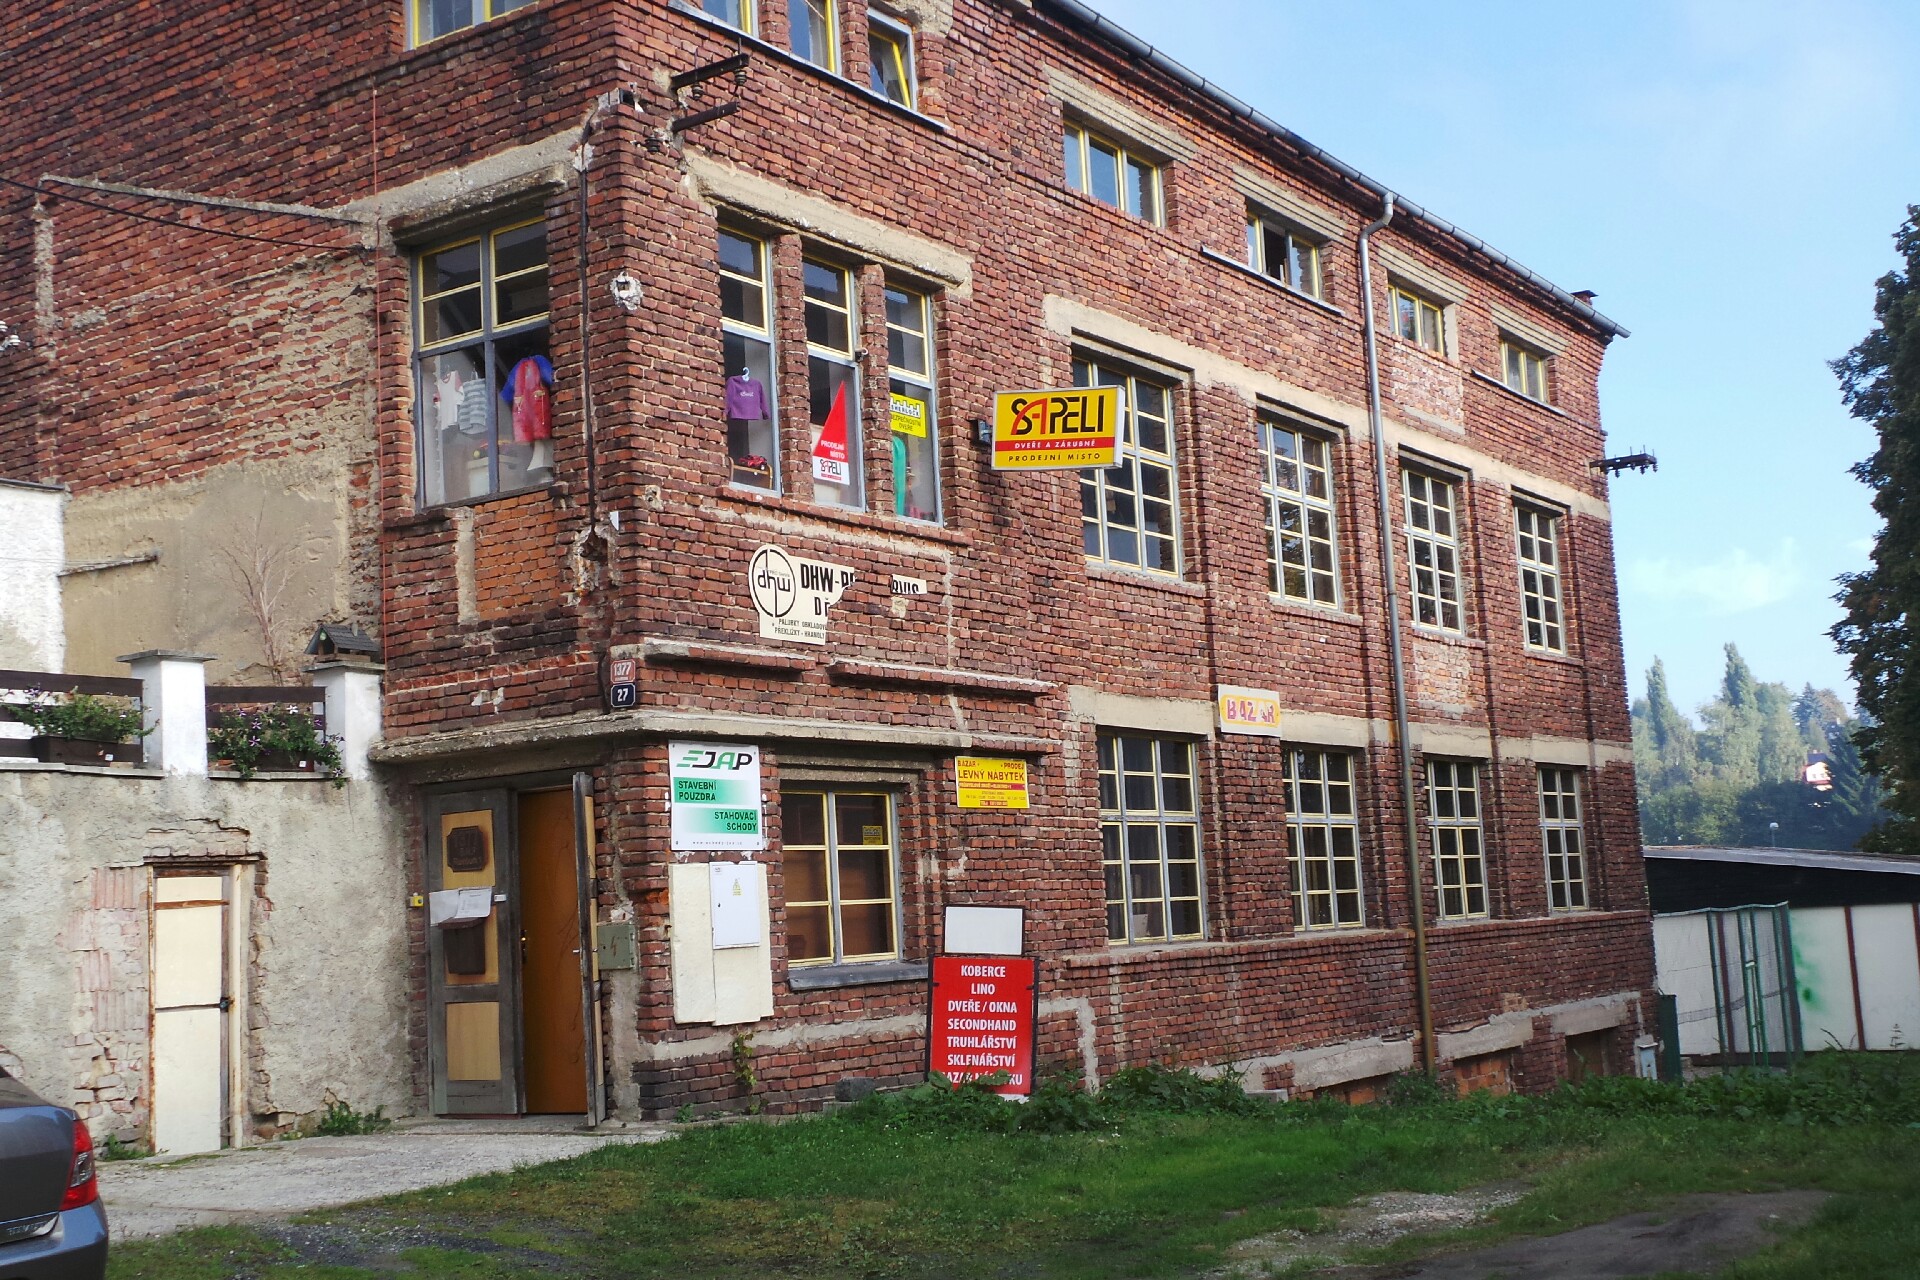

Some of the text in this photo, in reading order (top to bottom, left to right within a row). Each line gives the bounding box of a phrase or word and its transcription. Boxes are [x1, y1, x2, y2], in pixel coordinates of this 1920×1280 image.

[1010, 395, 1105, 436] SAPELI
[1014, 440, 1041, 450] DVEŘE
[1054, 439, 1096, 449] ZÁRUBNĚ
[1008, 451, 1101, 463] PRODEJNÍ MÍSTO
[820, 459, 842, 476] SAPELI
[613, 661, 632, 677] 1377
[617, 687, 629, 702] 27
[1003, 762, 1025, 770] PRODEJ
[958, 768, 985, 780] LEVNÝ
[678, 779, 717, 791] STAVEBNÍ
[678, 791, 717, 801] POUZDRA
[714, 810, 757, 821] STAHOVACÍ
[726, 822, 758, 832] SCHODY
[961, 965, 1006, 978] KOBERCE
[971, 983, 996, 995] LINO
[948, 999, 981, 1012] DVEŘE
[989, 1002, 1017, 1013] OKNA
[947, 1018, 1017, 1030] SECONDHAND
[947, 1035, 1017, 1049] TRUHLÁŘSTVÍ
[947, 1053, 1015, 1067] SKLENÁŘSTVÍ
